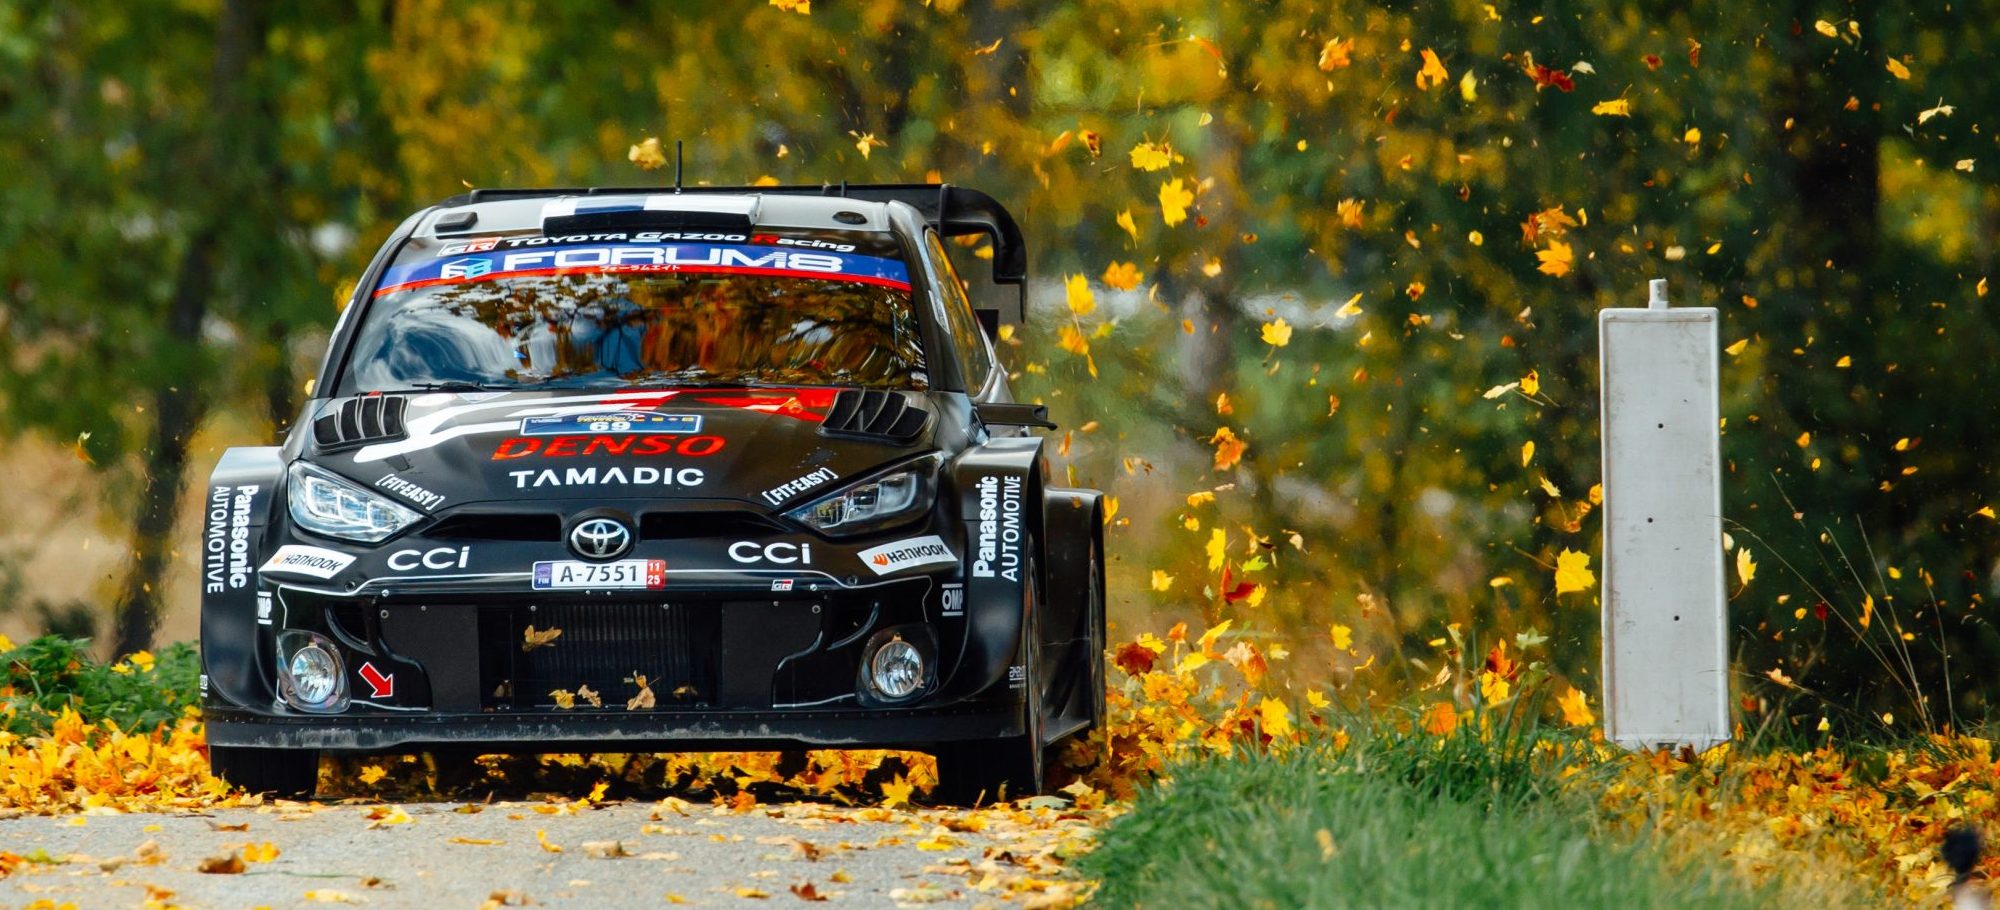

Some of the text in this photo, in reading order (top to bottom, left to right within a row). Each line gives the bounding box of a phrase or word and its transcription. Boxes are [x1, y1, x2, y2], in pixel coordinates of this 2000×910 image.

[506, 233, 626, 247] TOYOTA
[629, 232, 745, 242] GAZOO
[752, 234, 855, 252] Racing
[503, 247, 843, 272] FORUM8
[590, 421, 631, 431] 69
[491, 435, 727, 460] DENSO
[508, 467, 705, 488] TAMADIC
[229, 485, 260, 588] Panasonic
[973, 476, 998, 577] Panasonic
[1001, 476, 1021, 582] AUTOMOTIVE
[207, 486, 232, 594] AUTOMOTIVE
[560, 565, 637, 582] A-7551
[648, 562, 660, 571] 11
[647, 574, 661, 585] 25
